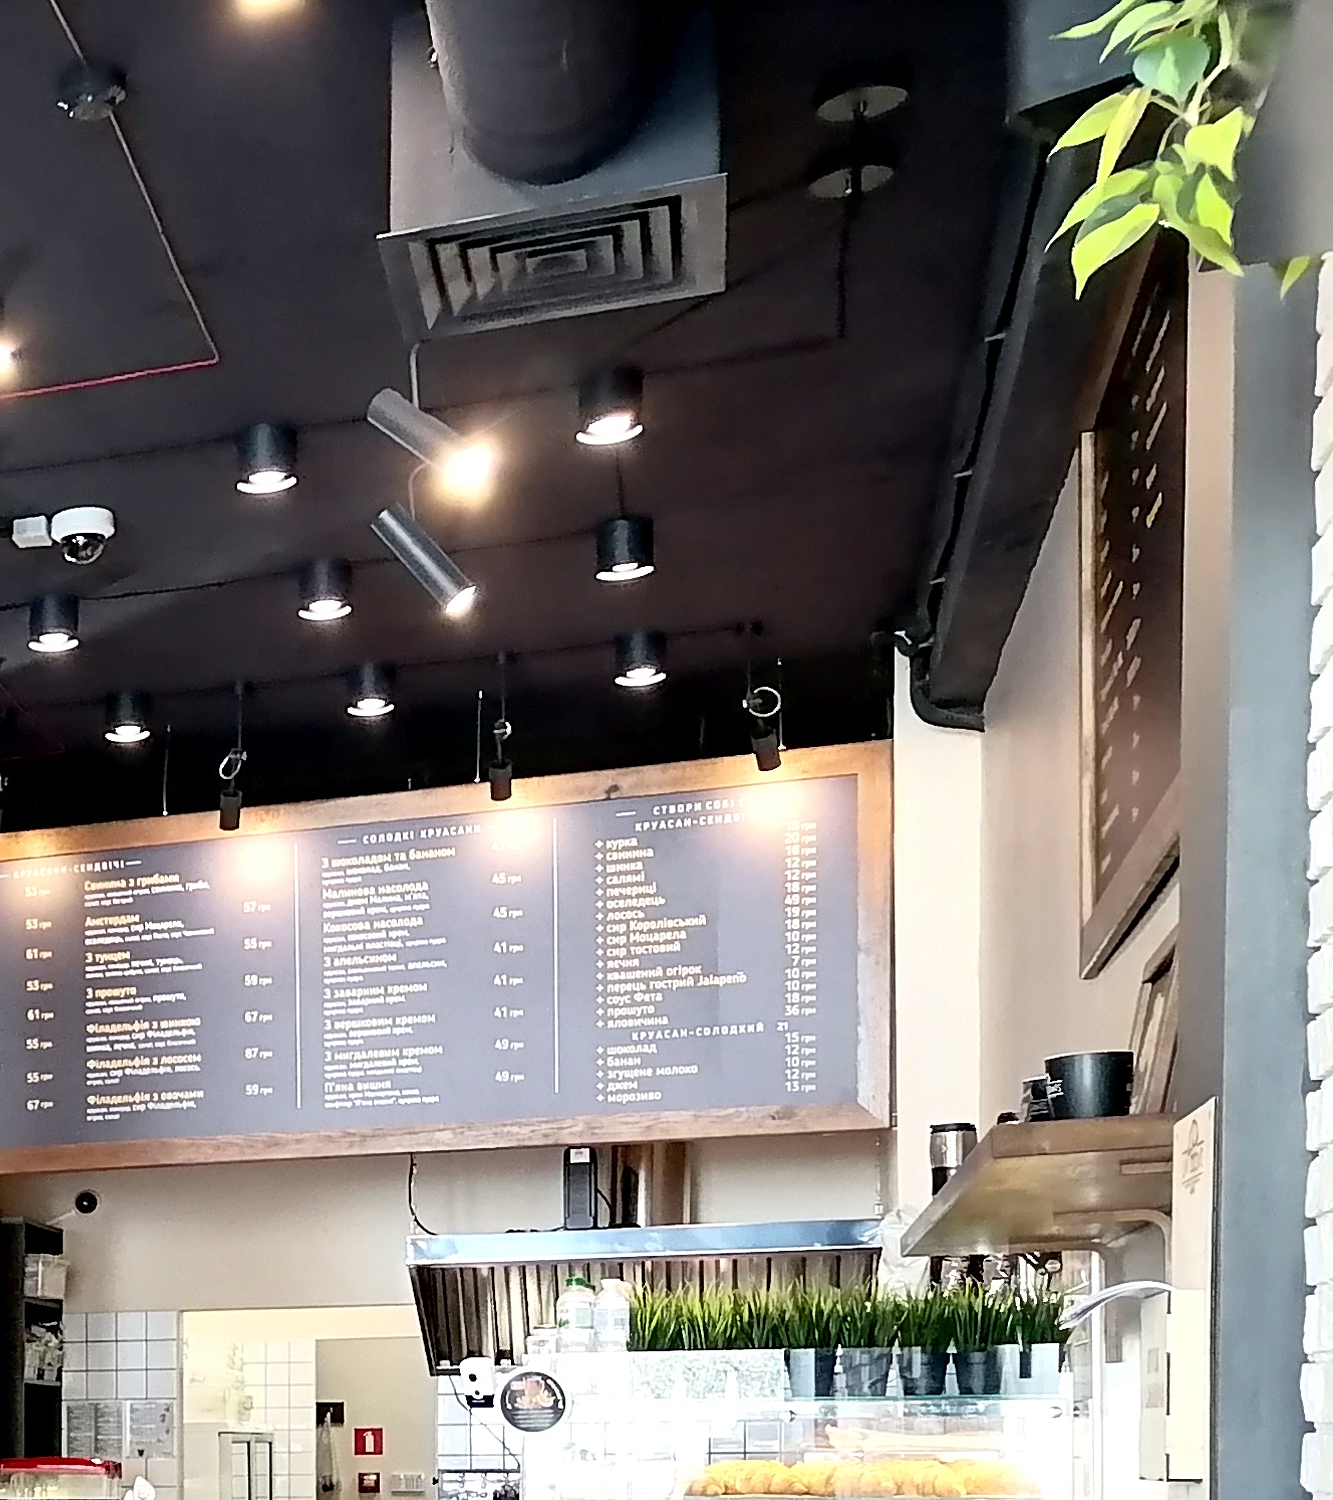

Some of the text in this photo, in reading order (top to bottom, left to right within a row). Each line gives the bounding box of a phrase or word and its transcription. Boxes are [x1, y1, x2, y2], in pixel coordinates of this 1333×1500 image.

[653, 802, 702, 815] СТВОРИ
[706, 799, 734, 810] СОБІ
[363, 825, 481, 844] СОЛОДКІ КРУАСАНИ
[785, 832, 800, 844] 20
[606, 838, 638, 852] курка
[322, 847, 455, 868] З шоколадом та бананом
[606, 848, 654, 862] свинина
[606, 861, 643, 873] шинка
[785, 858, 800, 868] 12
[137, 874, 179, 887] грибами
[492, 873, 506, 884] 45
[606, 873, 645, 885] салямі
[785, 870, 800, 881] 12
[322, 881, 429, 899] Малинова насолода
[606, 883, 657, 898] печериці
[786, 883, 800, 893] 18
[606, 897, 665, 910] оселедець
[785, 895, 800, 905] 49
[243, 902, 256, 913] 57
[493, 908, 507, 918] 45
[785, 907, 800, 918] 19
[85, 914, 140, 927] Амстердам
[607, 910, 645, 921] лосось
[26, 920, 38, 929] 53
[323, 917, 423, 934] Кокосова насолода
[607, 915, 707, 934] сир Королівський
[785, 919, 800, 929] 18
[607, 931, 686, 946] сир Моцарела
[785, 931, 800, 942] 10
[244, 939, 257, 949] 55
[494, 943, 507, 953] 41
[785, 944, 800, 954] 12
[26, 949, 38, 959] 61
[85, 951, 130, 963] З тунцем
[607, 944, 681, 959] сир тостовий
[324, 954, 397, 967] З апельсином
[607, 958, 640, 968] яєчня
[792, 957, 800, 966] 7
[607, 964, 702, 981] квашений огірок
[785, 969, 800, 979] 10
[245, 975, 257, 986] 59
[494, 975, 507, 985] 41
[26, 981, 39, 991] 53
[324, 983, 427, 999] З заварним кремом
[607, 982, 647, 994] перець
[650, 978, 695, 991] гострий
[785, 981, 800, 991] 10
[86, 987, 137, 998] З прошуто
[607, 991, 663, 1006] соус Фета
[785, 993, 816, 1004] 18 грн
[27, 1009, 40, 1020] 61
[245, 1011, 258, 1022] 67
[494, 1007, 507, 1017] 41
[607, 1005, 655, 1019] прошуто
[785, 1006, 816, 1016] 36 грн
[86, 1020, 149, 1034] Філадельфія
[325, 1014, 435, 1030] З вершковим кремом
[607, 1016, 669, 1029] яловичина
[776, 1022, 789, 1032] 21
[632, 1023, 765, 1041] КРУАСАН-СОЛОДКИЙ
[26, 1039, 39, 1049] 55
[495, 1039, 509, 1049] 49
[785, 1033, 816, 1044] 15 грн
[245, 1048, 258, 1059] 87
[325, 1045, 443, 1062] З мигдалевим кремом
[607, 1044, 657, 1056] шоколад
[785, 1045, 816, 1056] 12 грн
[86, 1057, 150, 1069] Філадельфія
[161, 1054, 201, 1064] лососем
[607, 1057, 641, 1068] банан
[785, 1057, 816, 1068] 10 грн
[27, 1073, 39, 1083] 55
[495, 1071, 509, 1082] 49
[607, 1065, 698, 1080] згущене молоко
[785, 1070, 816, 1081] 12 грн
[245, 1085, 258, 1095] 59
[325, 1079, 391, 1092] П'яна вишня
[607, 1082, 638, 1093] джем
[785, 1082, 816, 1093] 13 грн
[86, 1093, 150, 1105] Філадельфія
[153, 1093, 158, 1101] з
[607, 1092, 662, 1104] морозиво
[27, 1101, 39, 1110] 67
